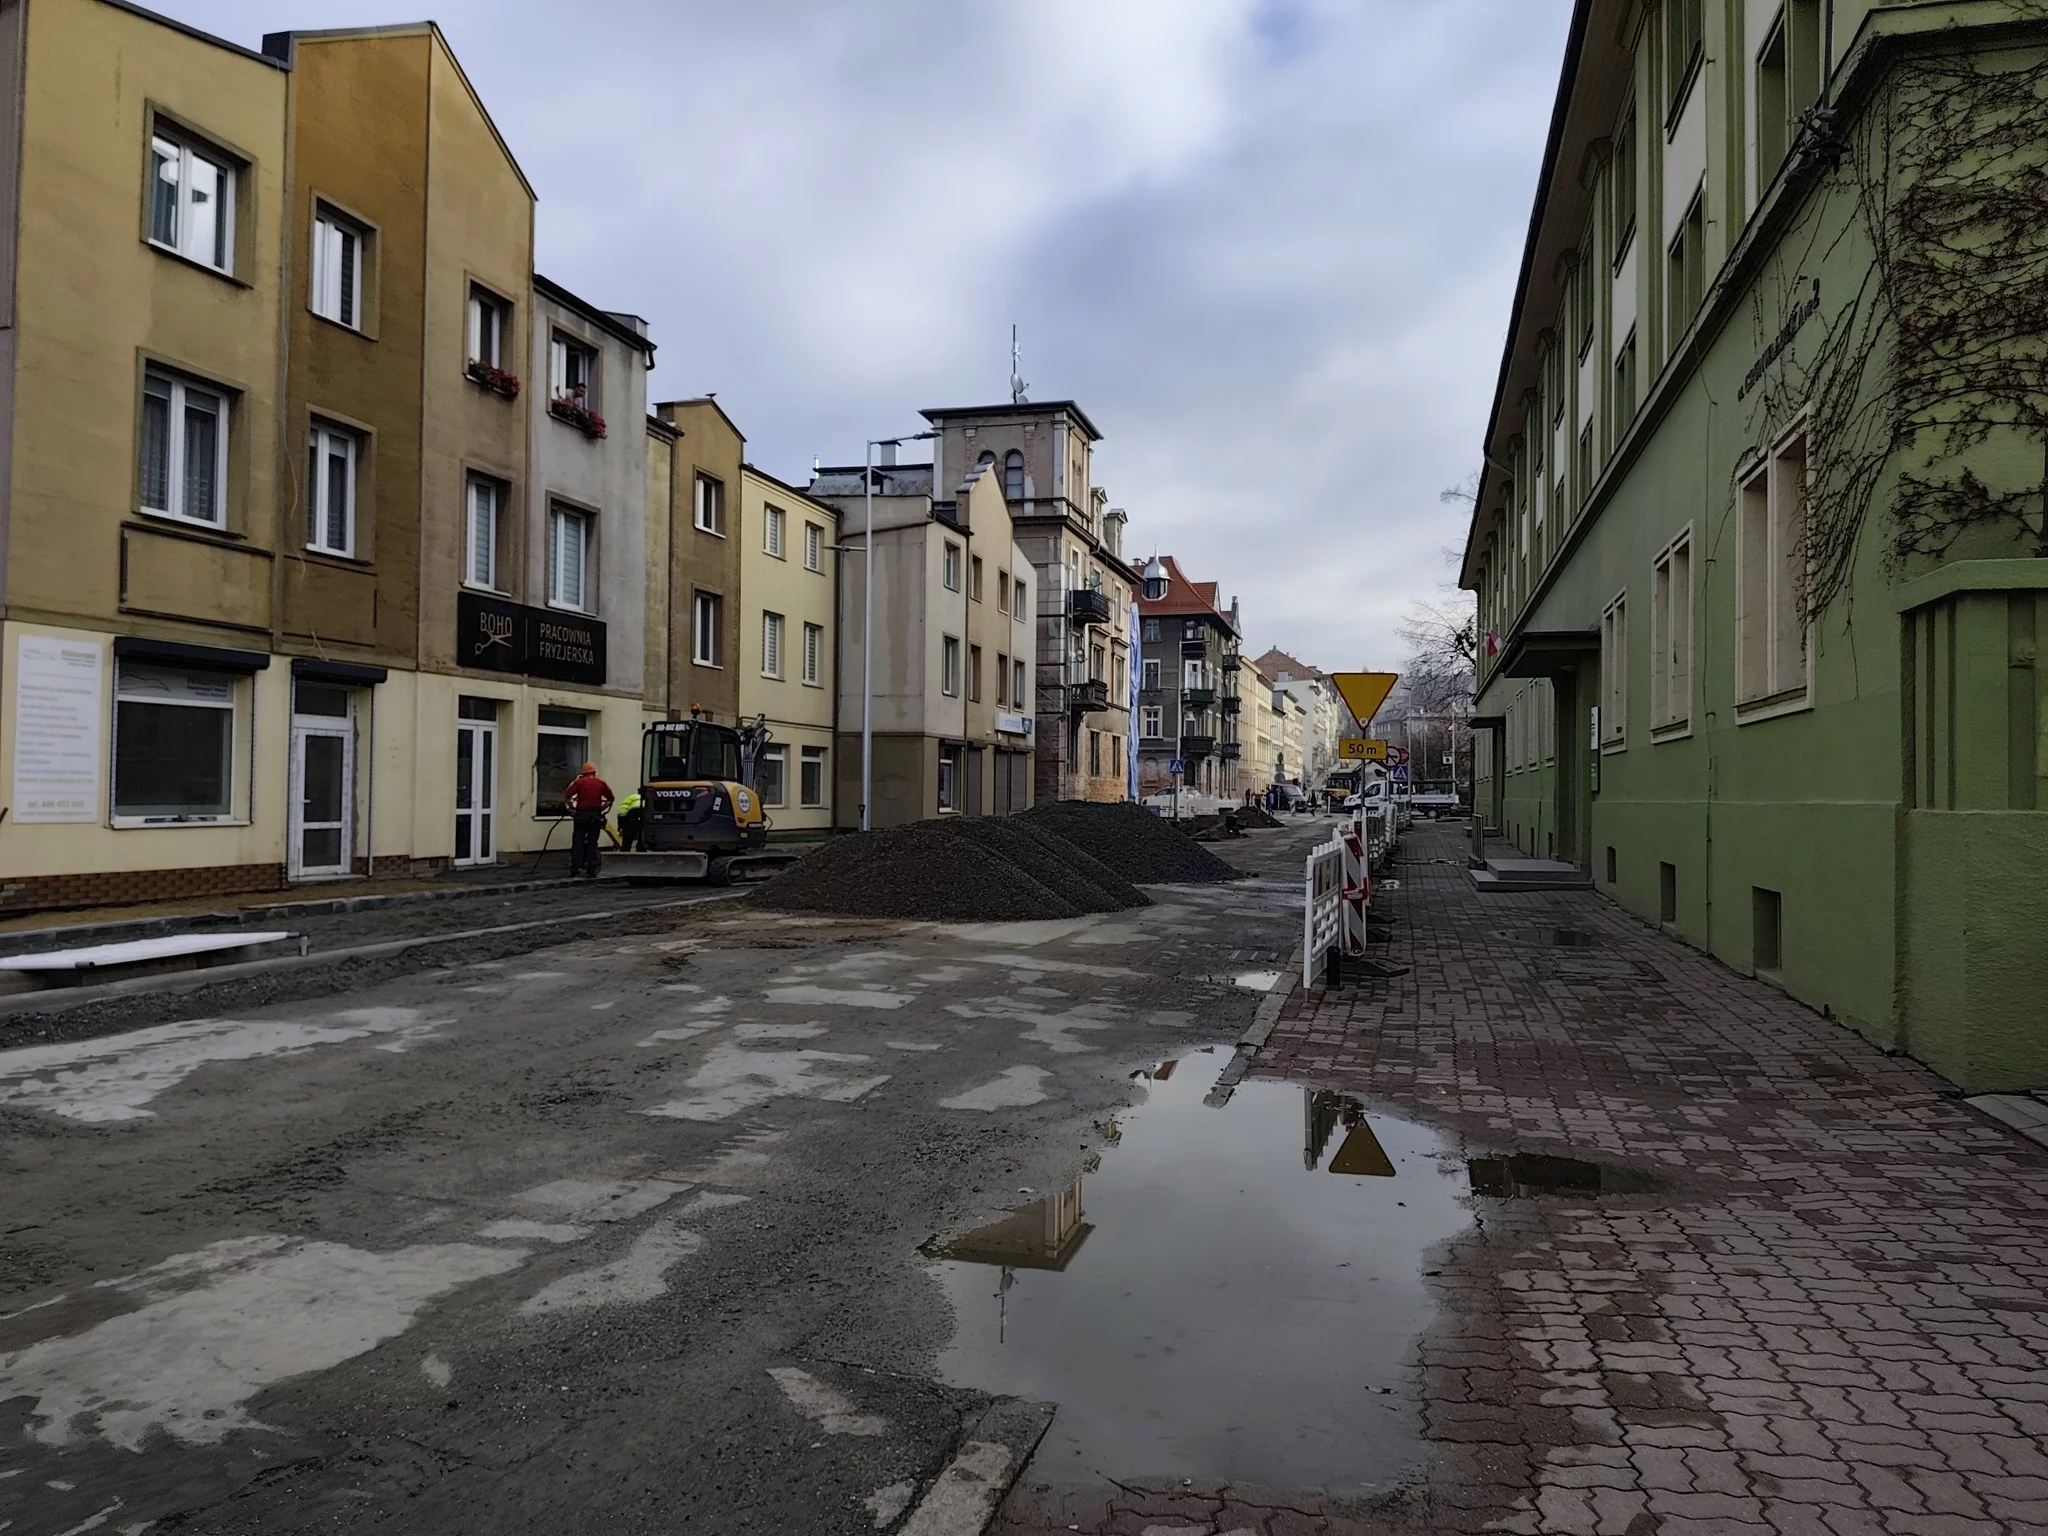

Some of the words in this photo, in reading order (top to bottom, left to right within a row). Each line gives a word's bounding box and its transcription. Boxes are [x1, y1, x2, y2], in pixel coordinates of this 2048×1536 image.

[480, 611, 512, 635] BOHO
[540, 622, 591, 646] PRACOWNIA
[540, 641, 594, 664] FRYZJERSKA
[1348, 743, 1364, 754] 50
[1366, 746, 1377, 755] m
[656, 790, 691, 798] VOLVO
